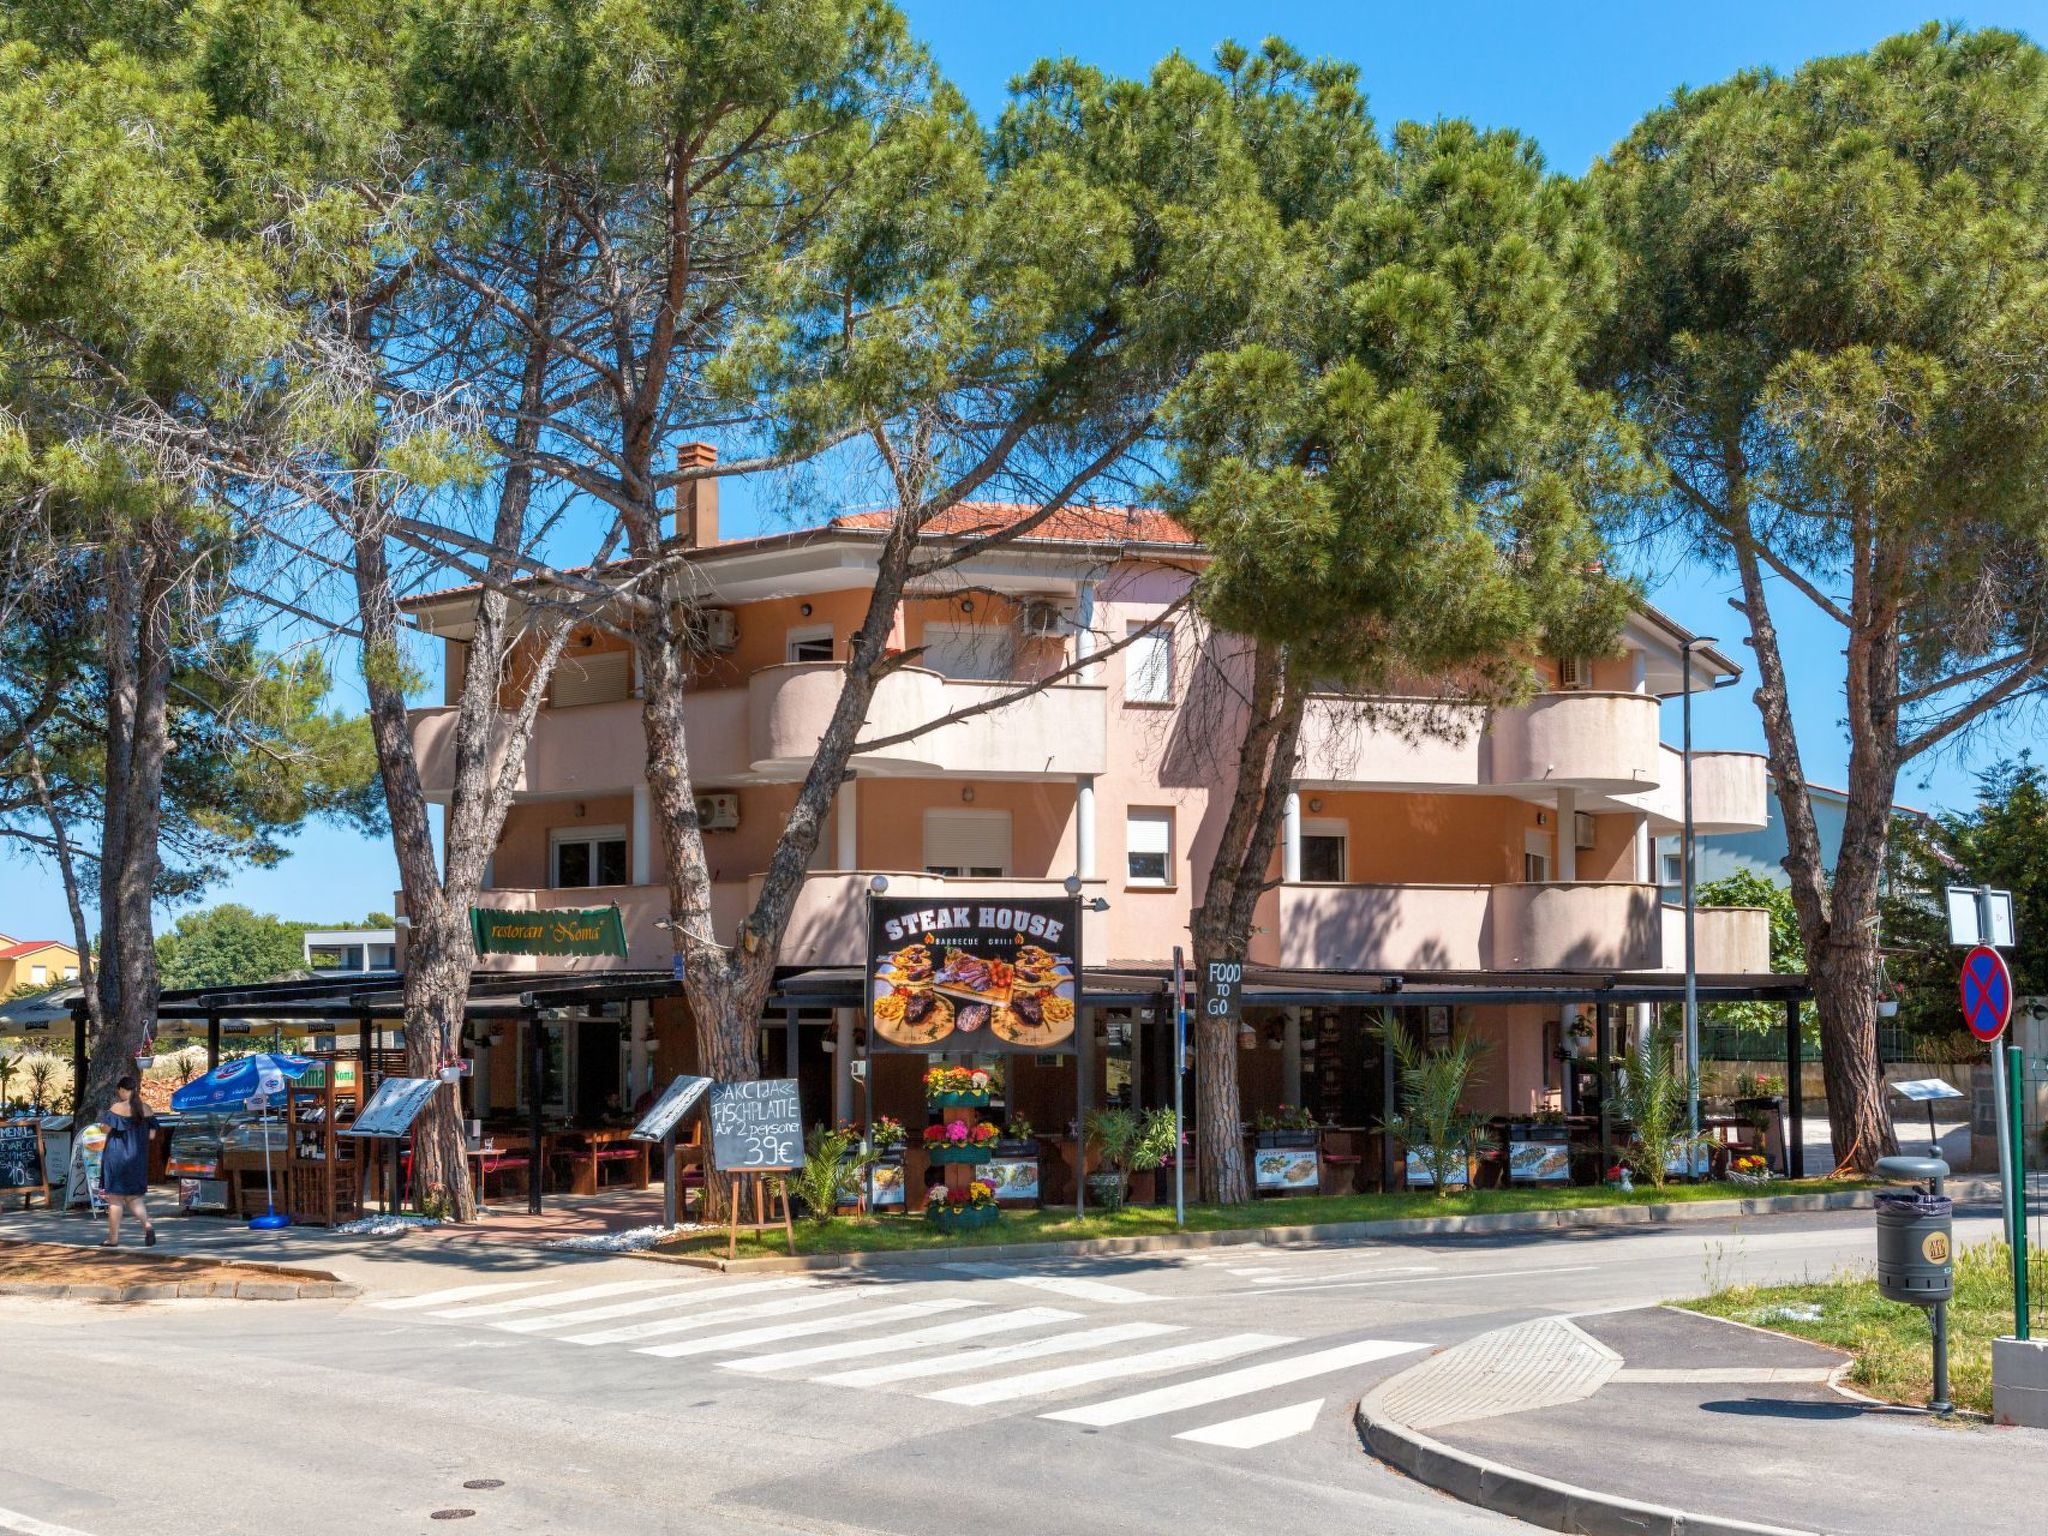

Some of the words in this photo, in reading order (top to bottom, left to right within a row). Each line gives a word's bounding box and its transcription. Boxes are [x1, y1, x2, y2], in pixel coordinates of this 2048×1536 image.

[491, 923, 545, 939] restoran
[885, 907, 971, 941] STEAK
[978, 907, 1064, 943] HOUSE
[936, 937, 979, 946] BARBECUE
[1209, 962, 1241, 983] FOOD
[1216, 983, 1230, 997] TO
[1207, 997, 1228, 1015] GO
[712, 1098, 800, 1122] FISCHPLATTE
[737, 1121, 748, 1136] 2
[744, 1136, 794, 1165] 39€
